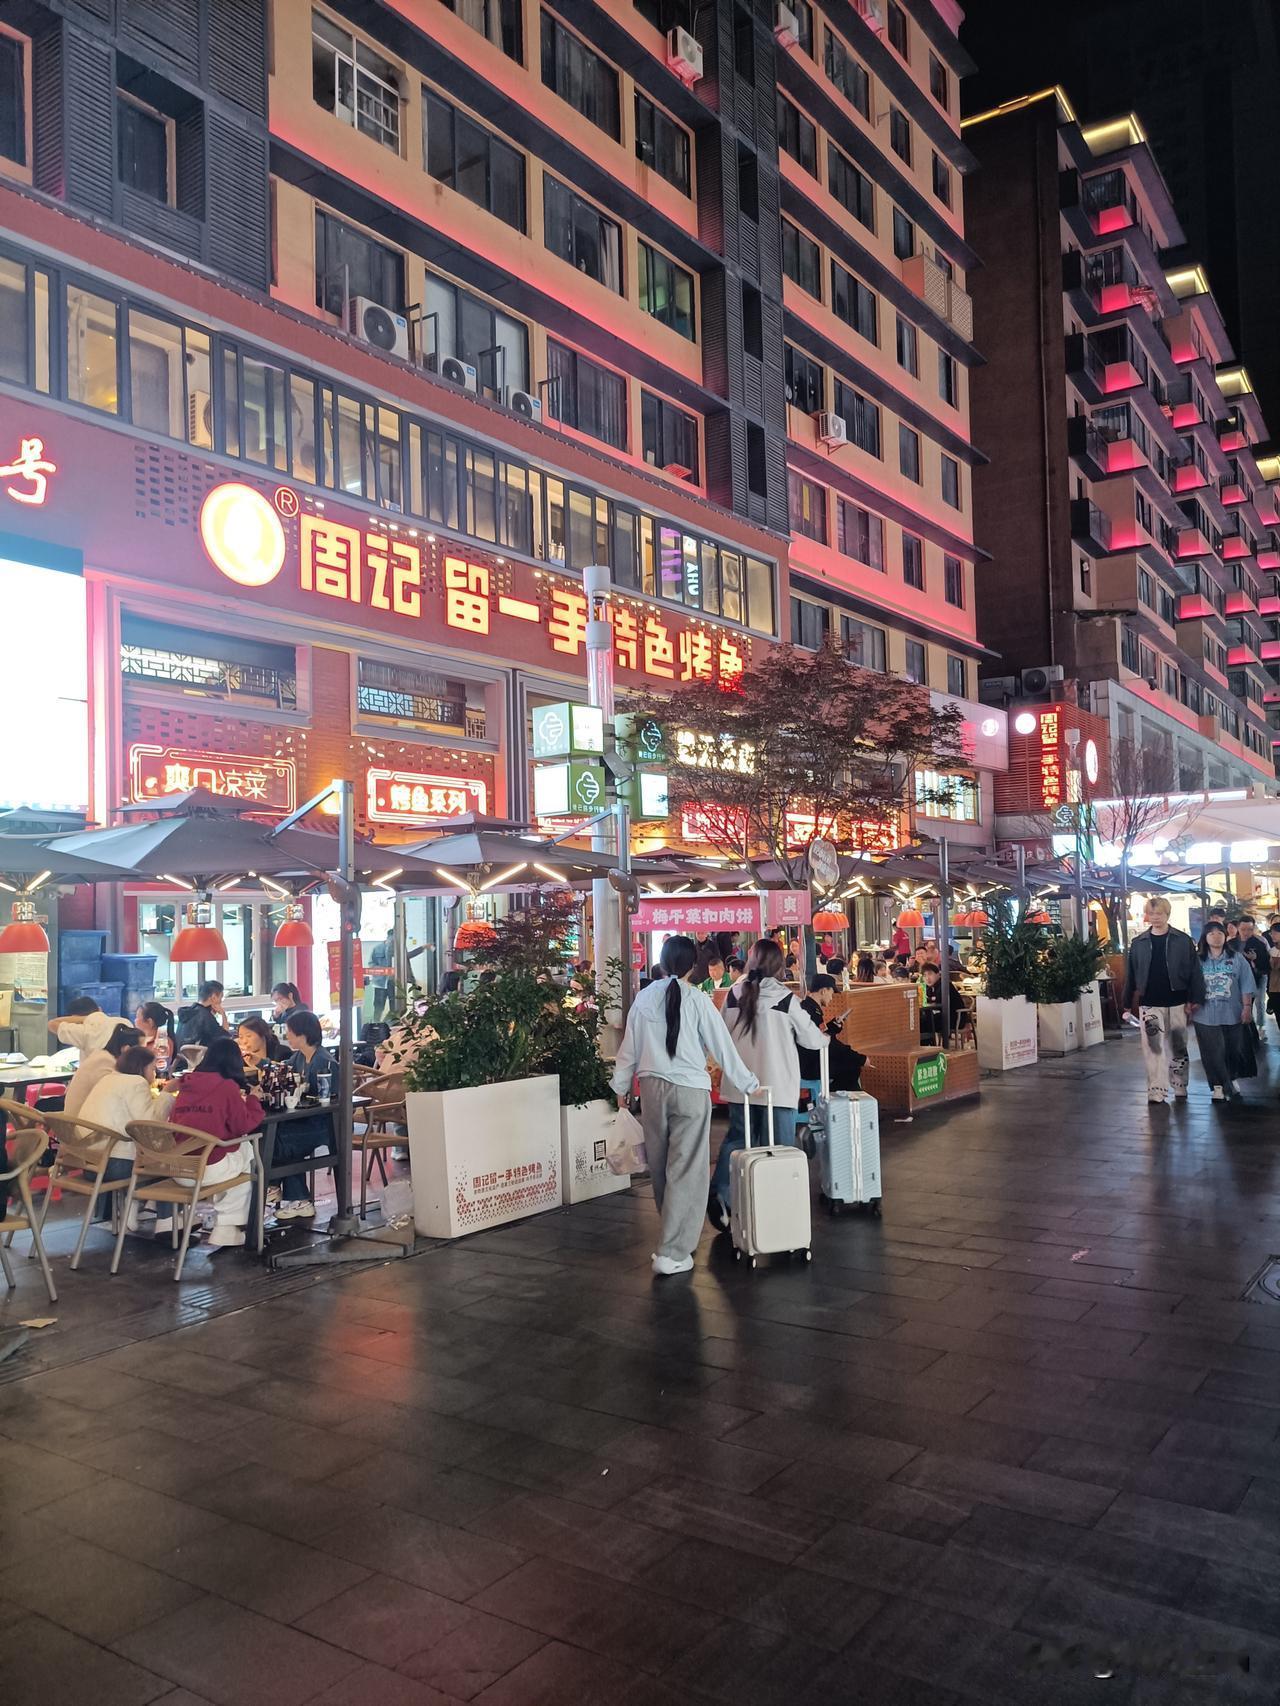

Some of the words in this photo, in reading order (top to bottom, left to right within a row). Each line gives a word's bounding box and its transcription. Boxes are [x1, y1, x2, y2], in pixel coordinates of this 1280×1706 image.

[0, 438, 57, 504] 号
[164, 763, 268, 799] 爽口凉菜
[390, 784, 467, 815] 烤鱼系列
[652, 907, 753, 925] 梅干菜扣肉饼
[472, 1162, 543, 1188] 周记留一手特色烤鱼
